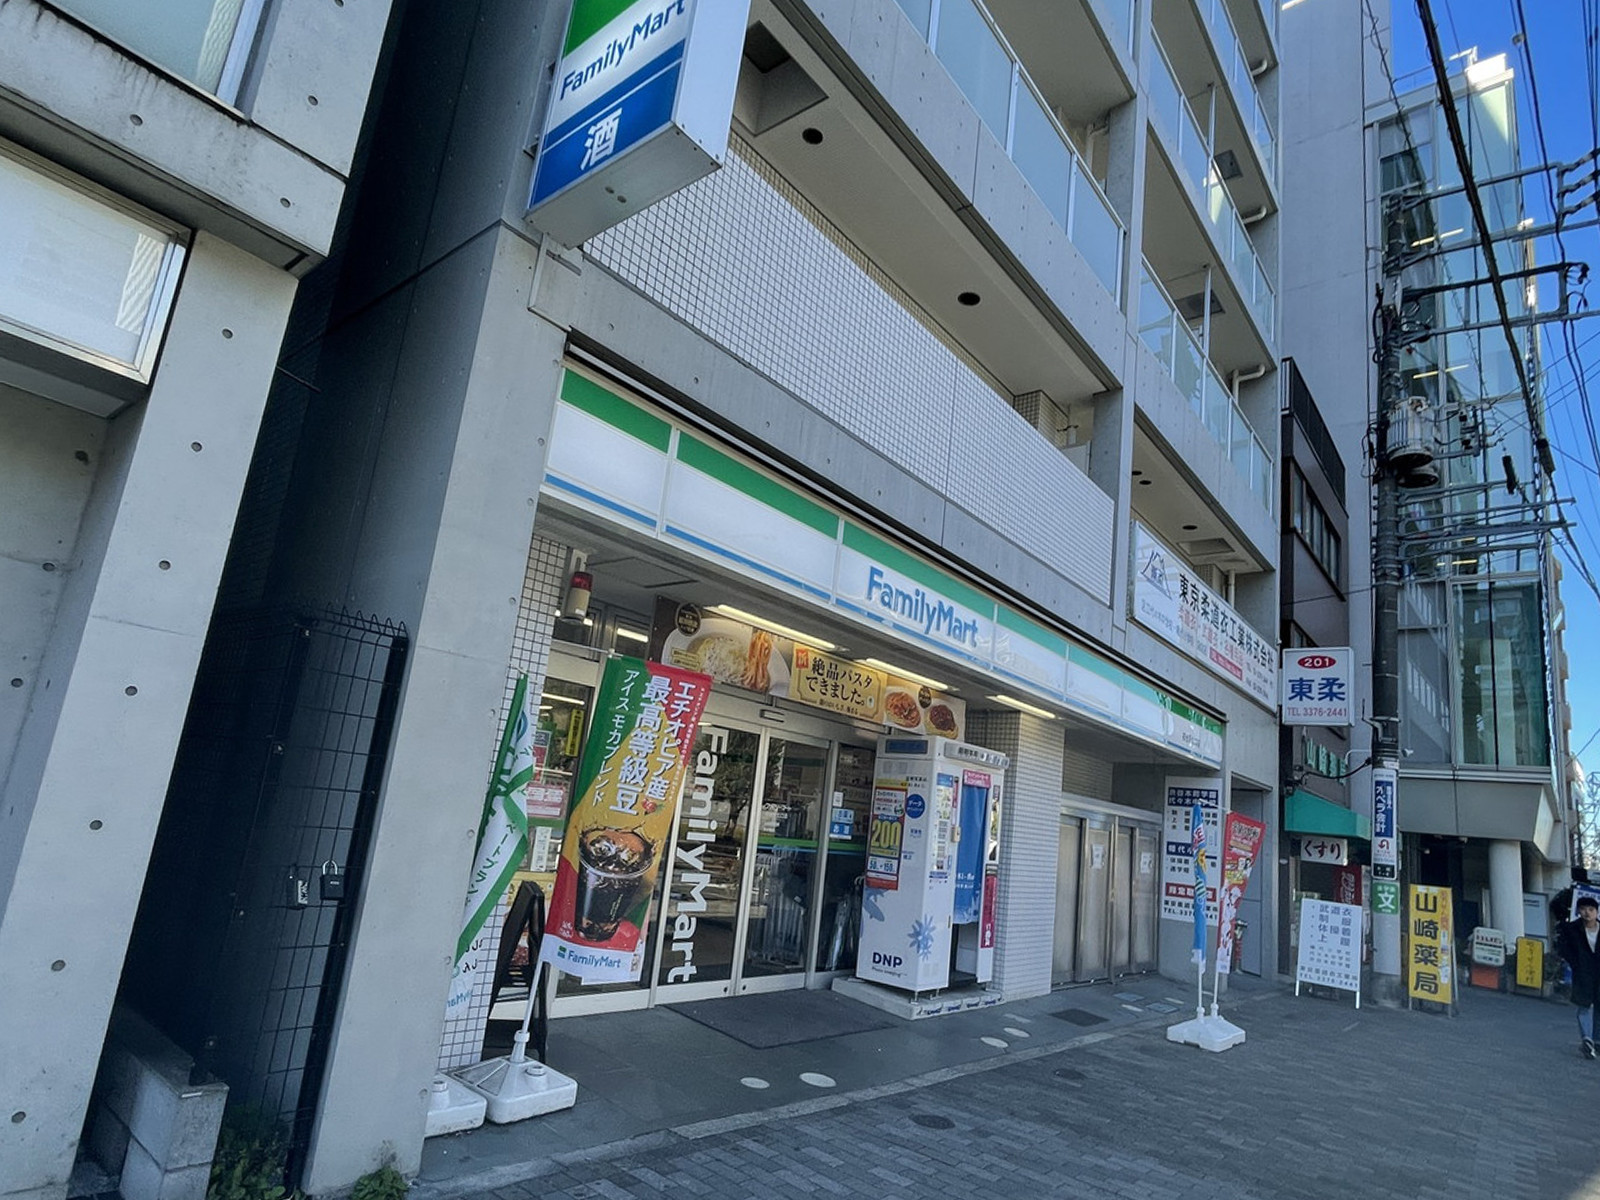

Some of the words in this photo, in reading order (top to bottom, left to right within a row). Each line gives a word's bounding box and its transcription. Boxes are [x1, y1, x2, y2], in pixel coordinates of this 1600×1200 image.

[560, 0, 686, 100] FamilyMart
[580, 107, 622, 171] 酒
[867, 565, 978, 648] FamilyMart
[811, 656, 873, 690] 絶品パスタ
[1304, 657, 1330, 668] 201
[806, 675, 865, 706] できました。
[1287, 677, 1346, 702] 東柔
[1287, 707, 1301, 716] TEL
[1303, 707, 1347, 717] 3376-2441
[608, 674, 673, 816] 最高等級豆
[645, 681, 697, 801] エチオピア産
[871, 820, 902, 849] 200
[1304, 840, 1341, 860] くすり
[667, 728, 729, 983] FamilyMart
[1377, 891, 1396, 910] 文
[567, 950, 622, 968] FamilyMart
[1414, 892, 1440, 995] 山崎薬局
[872, 951, 903, 968] DNP
